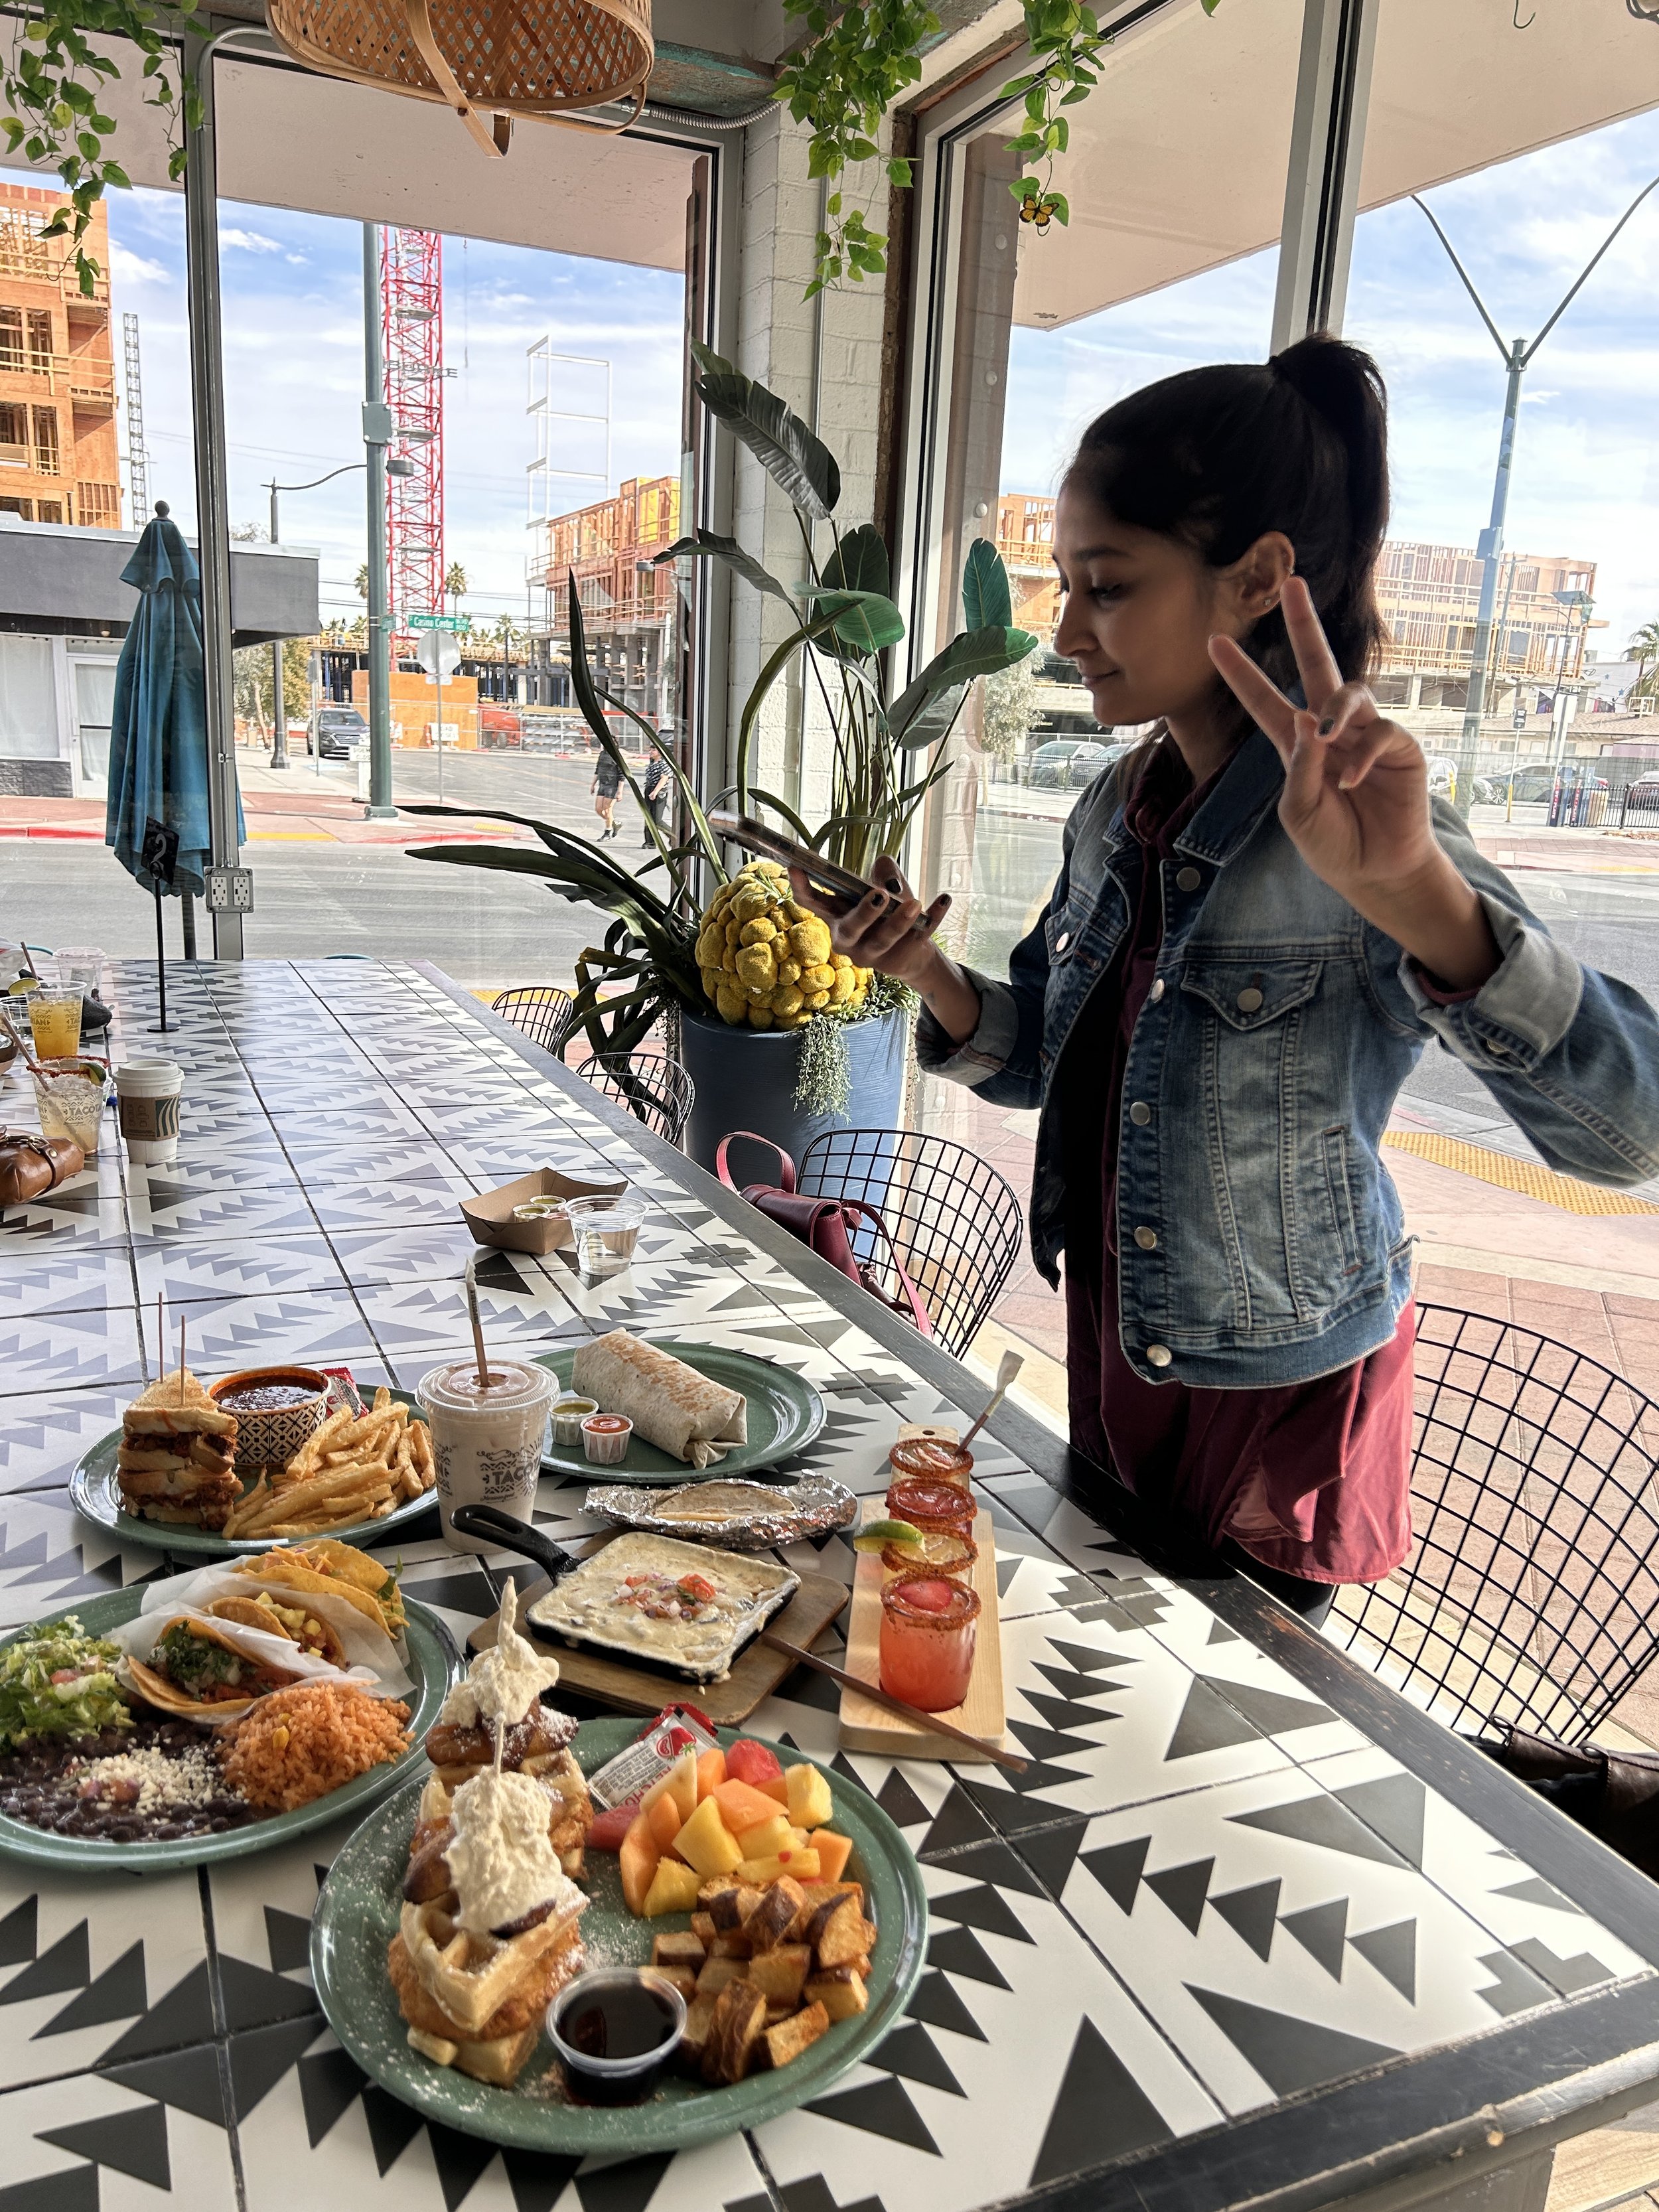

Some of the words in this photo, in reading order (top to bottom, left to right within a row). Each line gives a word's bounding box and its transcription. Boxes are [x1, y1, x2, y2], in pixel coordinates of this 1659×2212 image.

[413, 617, 434, 627] Casino
[435, 619, 454, 628] Center
[620, 1765, 672, 1806] KETCHU
